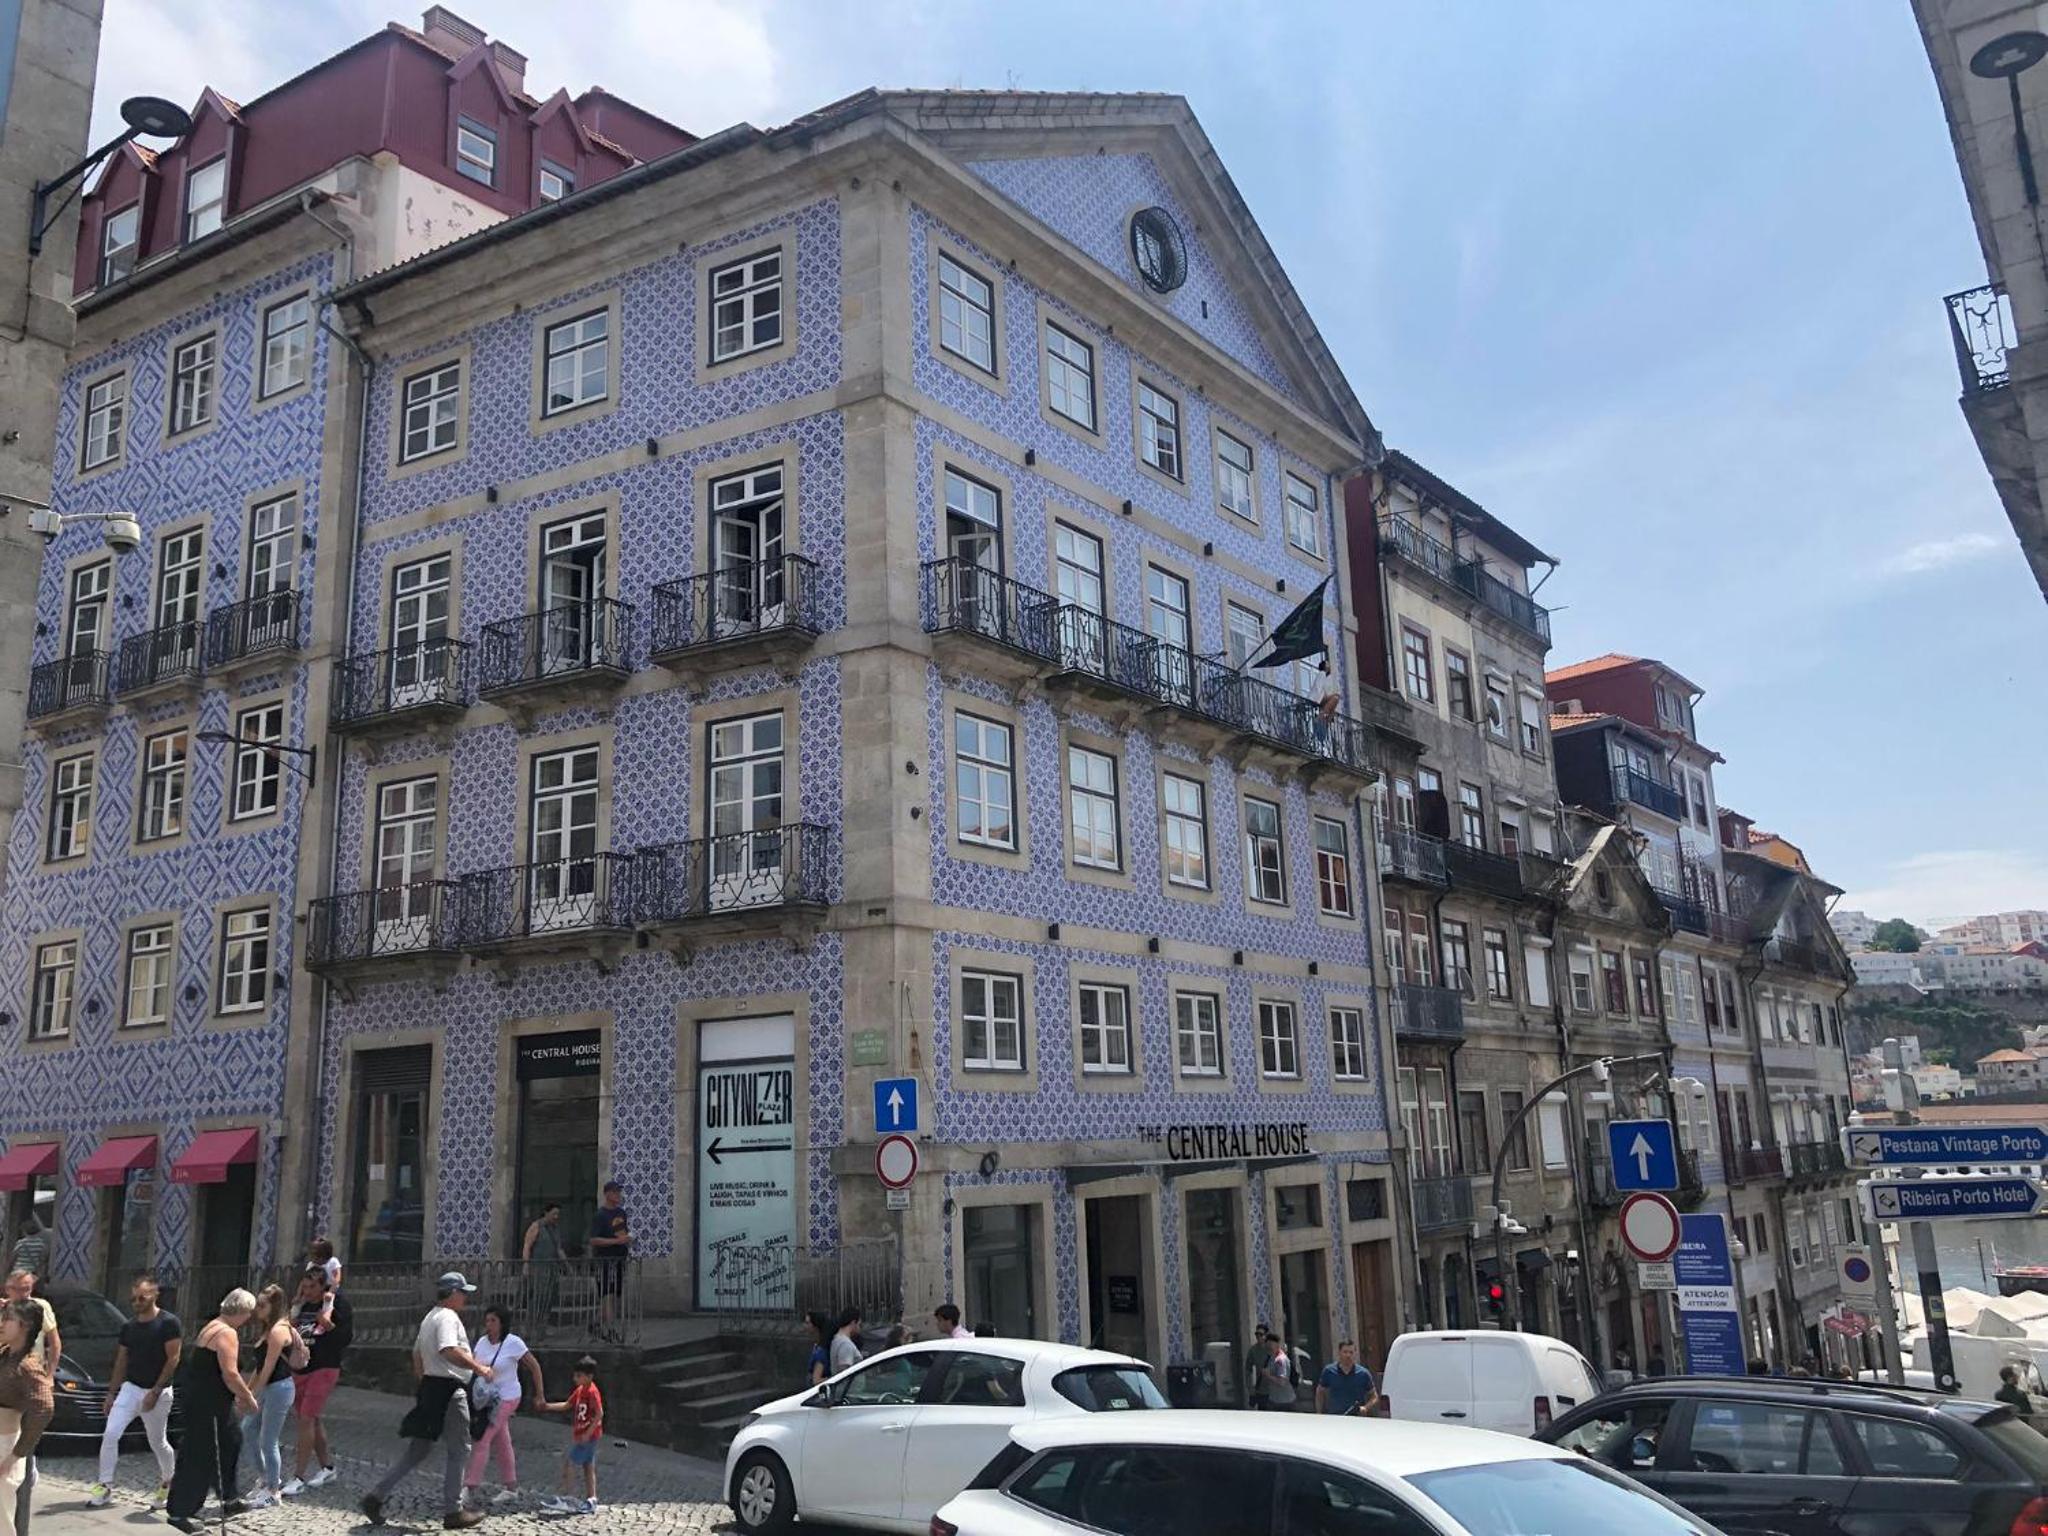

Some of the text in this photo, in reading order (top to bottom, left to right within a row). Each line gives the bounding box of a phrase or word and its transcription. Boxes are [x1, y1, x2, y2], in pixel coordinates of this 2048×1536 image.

[532, 1047, 570, 1059] CENTRAL
[571, 1043, 600, 1055] HOUSE
[707, 1070, 792, 1128] CITYNIZER
[758, 1102, 781, 1111] PLAZA
[1138, 1123, 1310, 1160] THE CENTRAL HOUSE
[1883, 1135, 2041, 1155] Pestana Vintage Porto
[1900, 1186, 2029, 1206] Ribeira Porto Hotel
[708, 1232, 746, 1250] COCKTAILS
